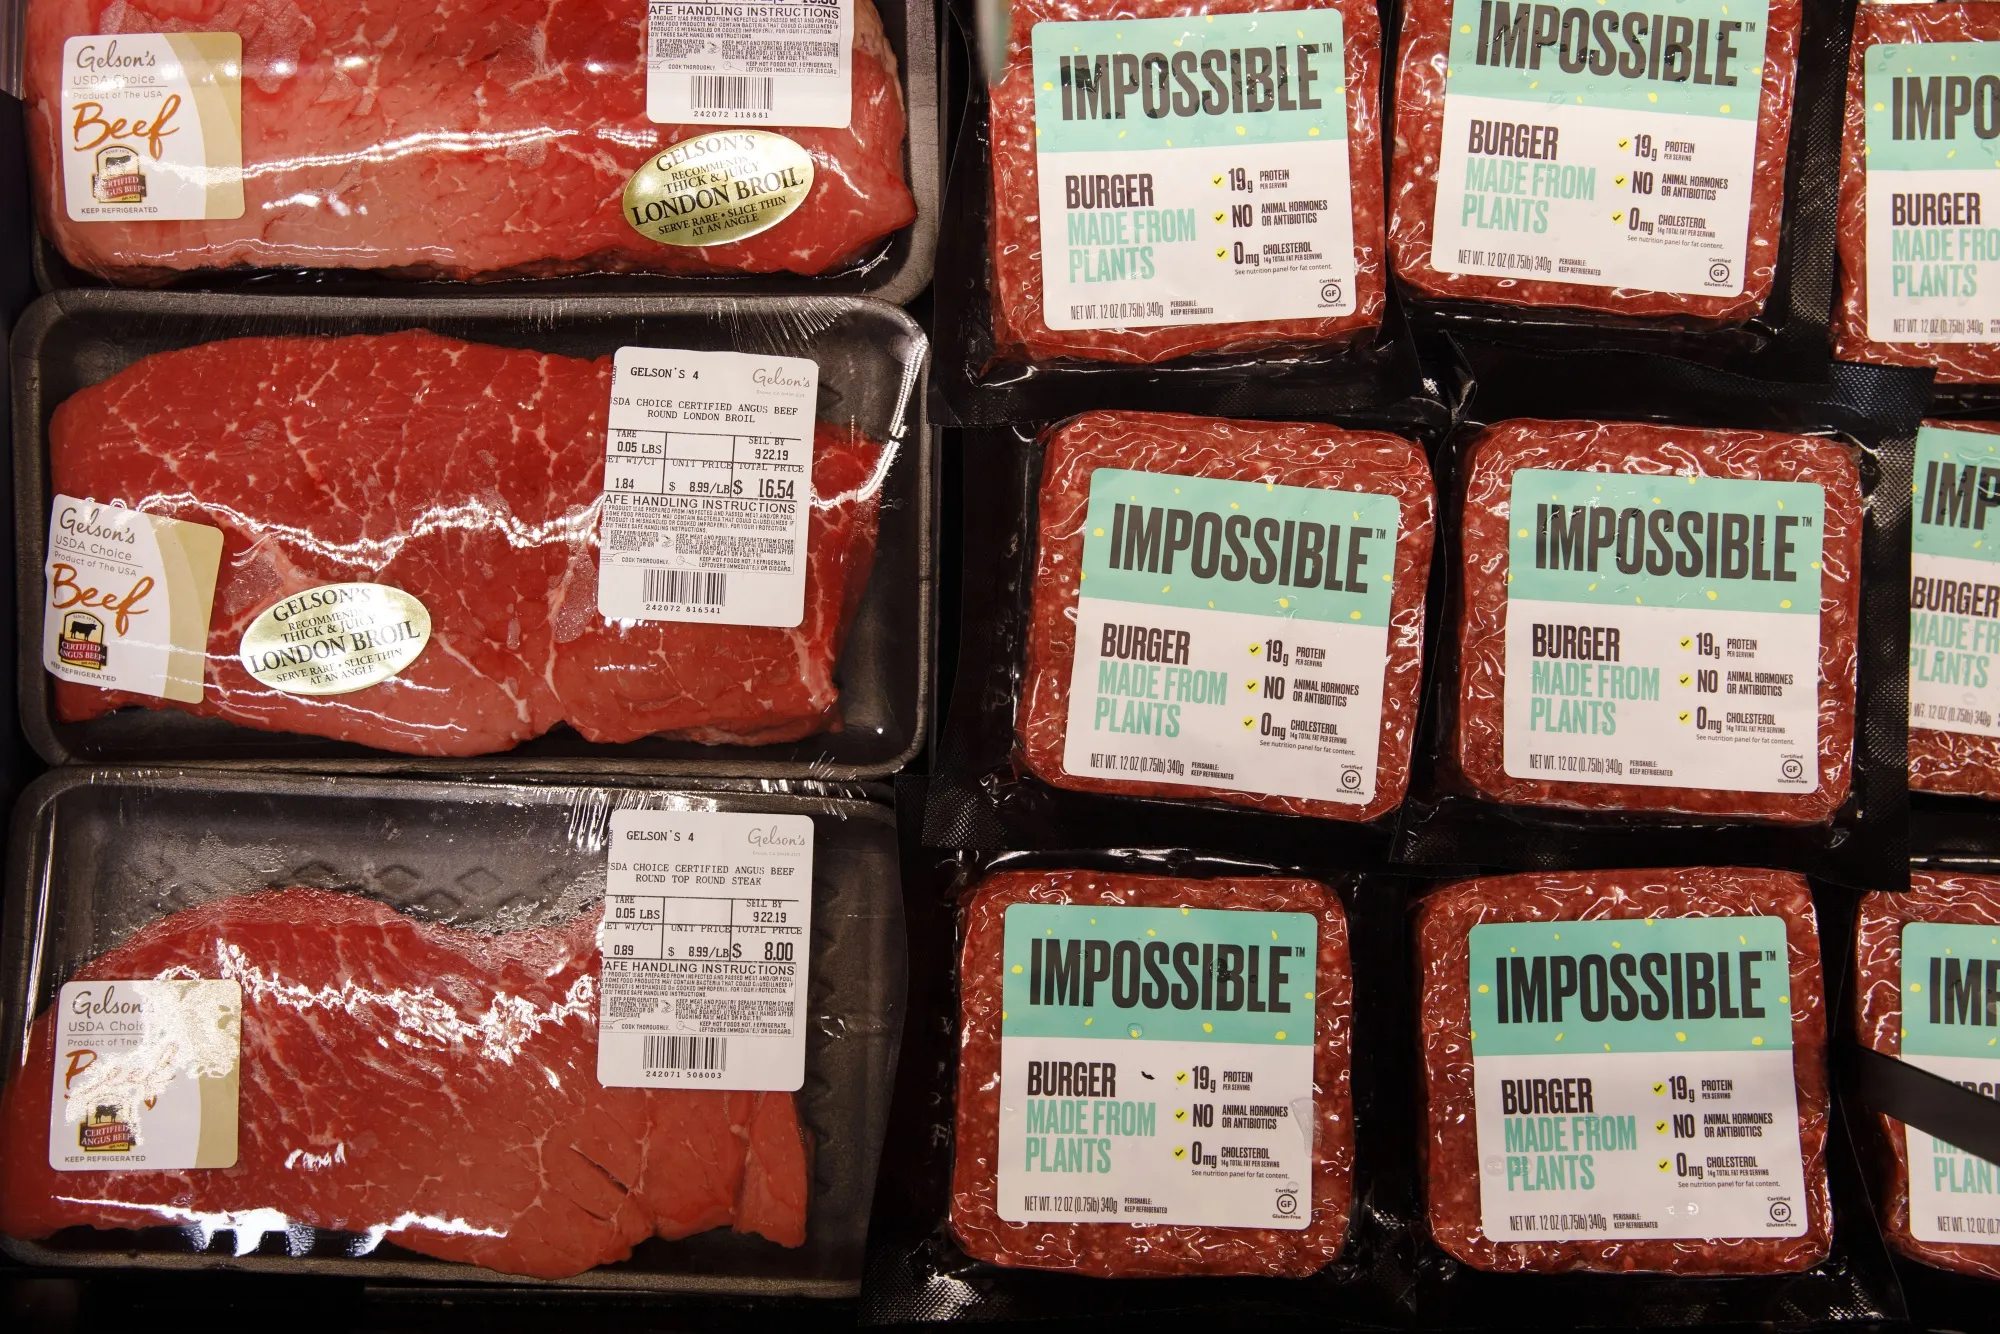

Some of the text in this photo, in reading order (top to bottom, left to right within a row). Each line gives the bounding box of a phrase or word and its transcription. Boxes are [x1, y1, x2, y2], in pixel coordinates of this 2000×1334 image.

[678, 5, 839, 19] HANDLING INSTRUCTIONS
[76, 40, 156, 72] Gelson's
[694, 110, 729, 118] 242072
[72, 94, 181, 160] Beef
[1467, 119, 1559, 161] BURGER
[1664, 140, 1696, 154] PROTEIN
[656, 135, 755, 172] GELSON'S
[1259, 168, 1290, 182] PROTEIN
[1464, 156, 1597, 201] MADE FROM
[1630, 170, 1654, 195] NO
[1661, 172, 1729, 190] ANIMAL HORMONES
[630, 166, 804, 226] LONDON BROIL
[1064, 171, 1154, 211] BURGER
[1671, 186, 1717, 201] ANTIBIOTICS
[101, 206, 158, 214] REFRIGERATED
[658, 195, 787, 235] SERVE RARE SLICE THIN
[1231, 203, 1253, 228] NO
[1260, 199, 1328, 214] ANIMAL HORMONES
[1461, 193, 1549, 235] PLANTS
[1891, 191, 1981, 226] BURGER
[724, 213, 759, 229] ANGLE
[1066, 207, 1196, 247] MADE FROM
[1272, 212, 1317, 226] ANTIBIOTICS
[1657, 213, 1708, 229] CHOLESTEROL
[1262, 241, 1312, 255] CHOLESTEROL
[1892, 228, 1953, 262] MADE
[1067, 245, 1155, 284] PLANTS
[1712, 268, 1726, 277] GF
[1892, 264, 1978, 298] PLANTS
[630, 367, 686, 379] GELSON'S
[752, 367, 810, 388] Gelson's
[636, 398, 799, 416] CHOICE CERTIFIED ANGUS BEEF
[647, 410, 755, 423] ROUND LONDON BROIL
[617, 441, 662, 455] 0.05 LBS
[615, 477, 635, 490] 1.84
[689, 481, 730, 495] 8.99/LB
[758, 478, 795, 499] 16.54
[633, 496, 796, 514] HANDLING INSTRUCTIONS
[59, 507, 136, 545] Gelson's
[55, 535, 133, 562] USDA Choice
[52, 563, 155, 638] Beef
[272, 587, 372, 622] GELSON'S
[1910, 576, 2000, 618] BURGER
[645, 604, 721, 614] 242072 816541
[1909, 612, 1970, 650] MADE
[248, 620, 421, 674] LONDON BROIL
[1100, 622, 1191, 666] BURGER
[1531, 622, 1621, 662] BURGER
[1726, 637, 1757, 651] PROTEIN
[1295, 645, 1326, 660] PROTEIN
[1096, 659, 1228, 707] MADE FROM
[1293, 677, 1359, 696] ANIMAL HORMONES
[1530, 660, 1660, 702] MADE FROM
[1696, 669, 1718, 694] NO
[1727, 670, 1793, 685] ANIMAL HORMONES
[1262, 675, 1285, 701] NO
[1738, 683, 1782, 697] ANTIBIOTICS
[1303, 691, 1348, 708] ANTIBIOTICS
[1093, 696, 1182, 739] PLANTS
[1529, 696, 1616, 736] PLANTS
[1726, 711, 1776, 725] CHOLESTEROL
[1289, 718, 1339, 735] CHOLESTEROL
[626, 830, 681, 842] GELSON'S
[748, 826, 806, 847] Gelson's
[635, 874, 762, 886] ROUND TOP ROUND STEAK
[613, 945, 634, 956] 0.89
[688, 946, 730, 958] 8.99/LB
[764, 941, 794, 961] 8.00
[646, 1071, 681, 1079] 242071
[1026, 1059, 1116, 1098] BURGER
[1222, 1070, 1253, 1083] PROTEIN
[1700, 1078, 1733, 1091] PROTEIN
[1501, 1077, 1593, 1115] BURGER
[1025, 1098, 1156, 1137] MADE FROM
[1192, 1103, 1213, 1128] NO
[1221, 1103, 1288, 1118] ANIMAL HORMONES
[1703, 1111, 1773, 1125] ANIMAL HORMONES
[1232, 1116, 1277, 1130] ANTIBIOTICS
[1672, 1113, 1695, 1139] NO
[1715, 1125, 1762, 1138] ANTIBIOTICS
[1503, 1115, 1638, 1153] MADE FROM
[1024, 1135, 1112, 1175] PLANTS
[1220, 1145, 1270, 1159] CHOLESTEROL
[1706, 1155, 1758, 1168] CHOLESTEROL
[1191, 1169, 1290, 1179] See nutrition panel for fat content.
[1505, 1153, 1595, 1192] PLANTS
[1024, 1194, 1118, 1215] NET WT. 12 OZ (0.75lb) 340g
